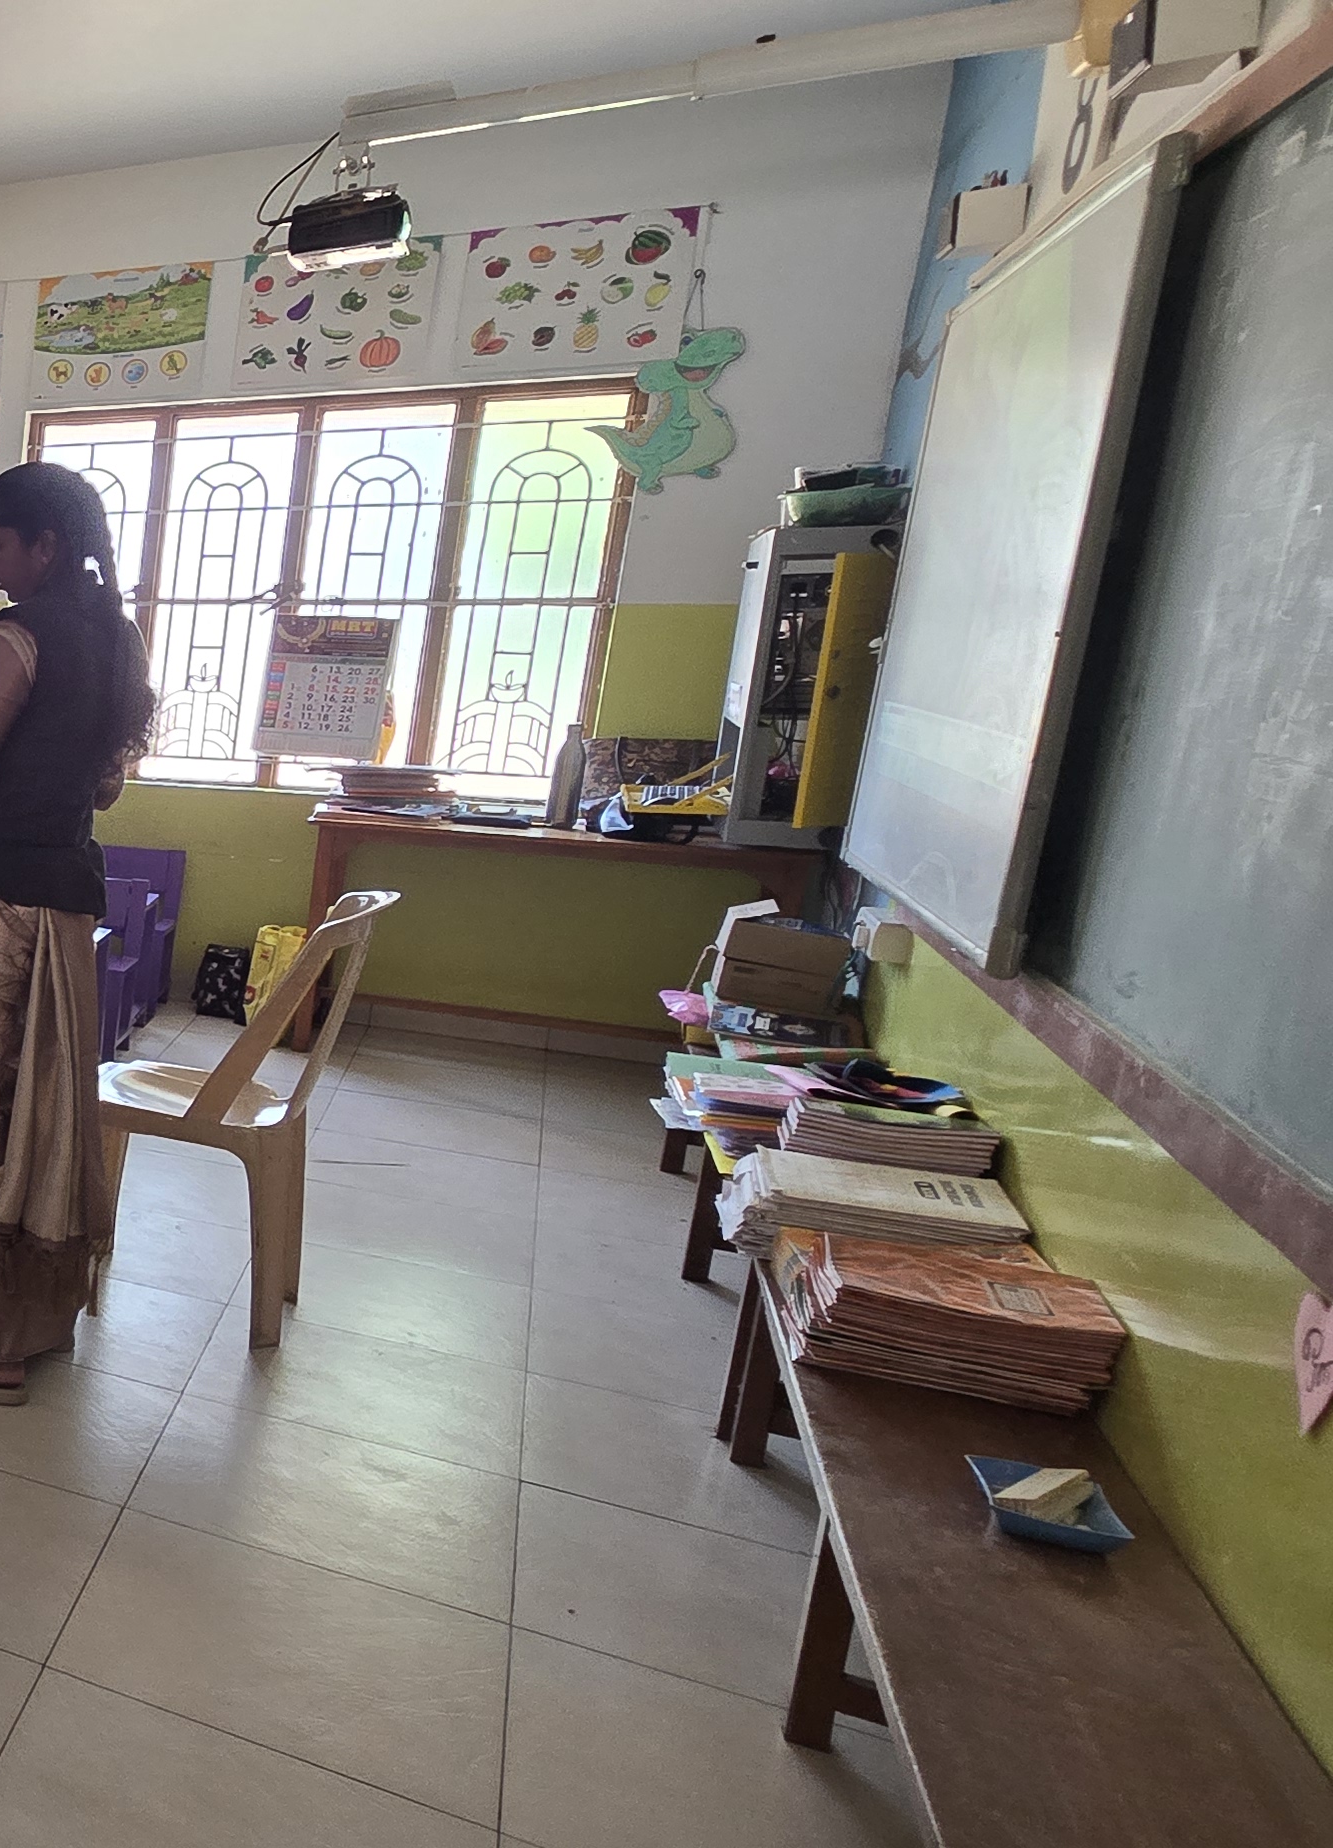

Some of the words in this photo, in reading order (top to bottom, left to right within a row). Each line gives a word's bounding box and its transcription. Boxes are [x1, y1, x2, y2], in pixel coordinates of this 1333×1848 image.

[312, 665, 318, 673] 6
[329, 666, 341, 674] 13
[348, 667, 361, 675] 20
[310, 675, 317, 683] 7
[327, 675, 340, 684] 14
[347, 676, 359, 684] 21
[365, 677, 379, 685] 28
[326, 685, 338, 693] 15
[363, 687, 376, 695] 29
[306, 693, 314, 701] 9
[324, 694, 336, 702] 16
[340, 705, 353, 713] 24
[301, 712, 311, 720] 11
[317, 713, 329, 721] 18
[319, 723, 330, 731] 19
[337, 724, 350, 732] 26
